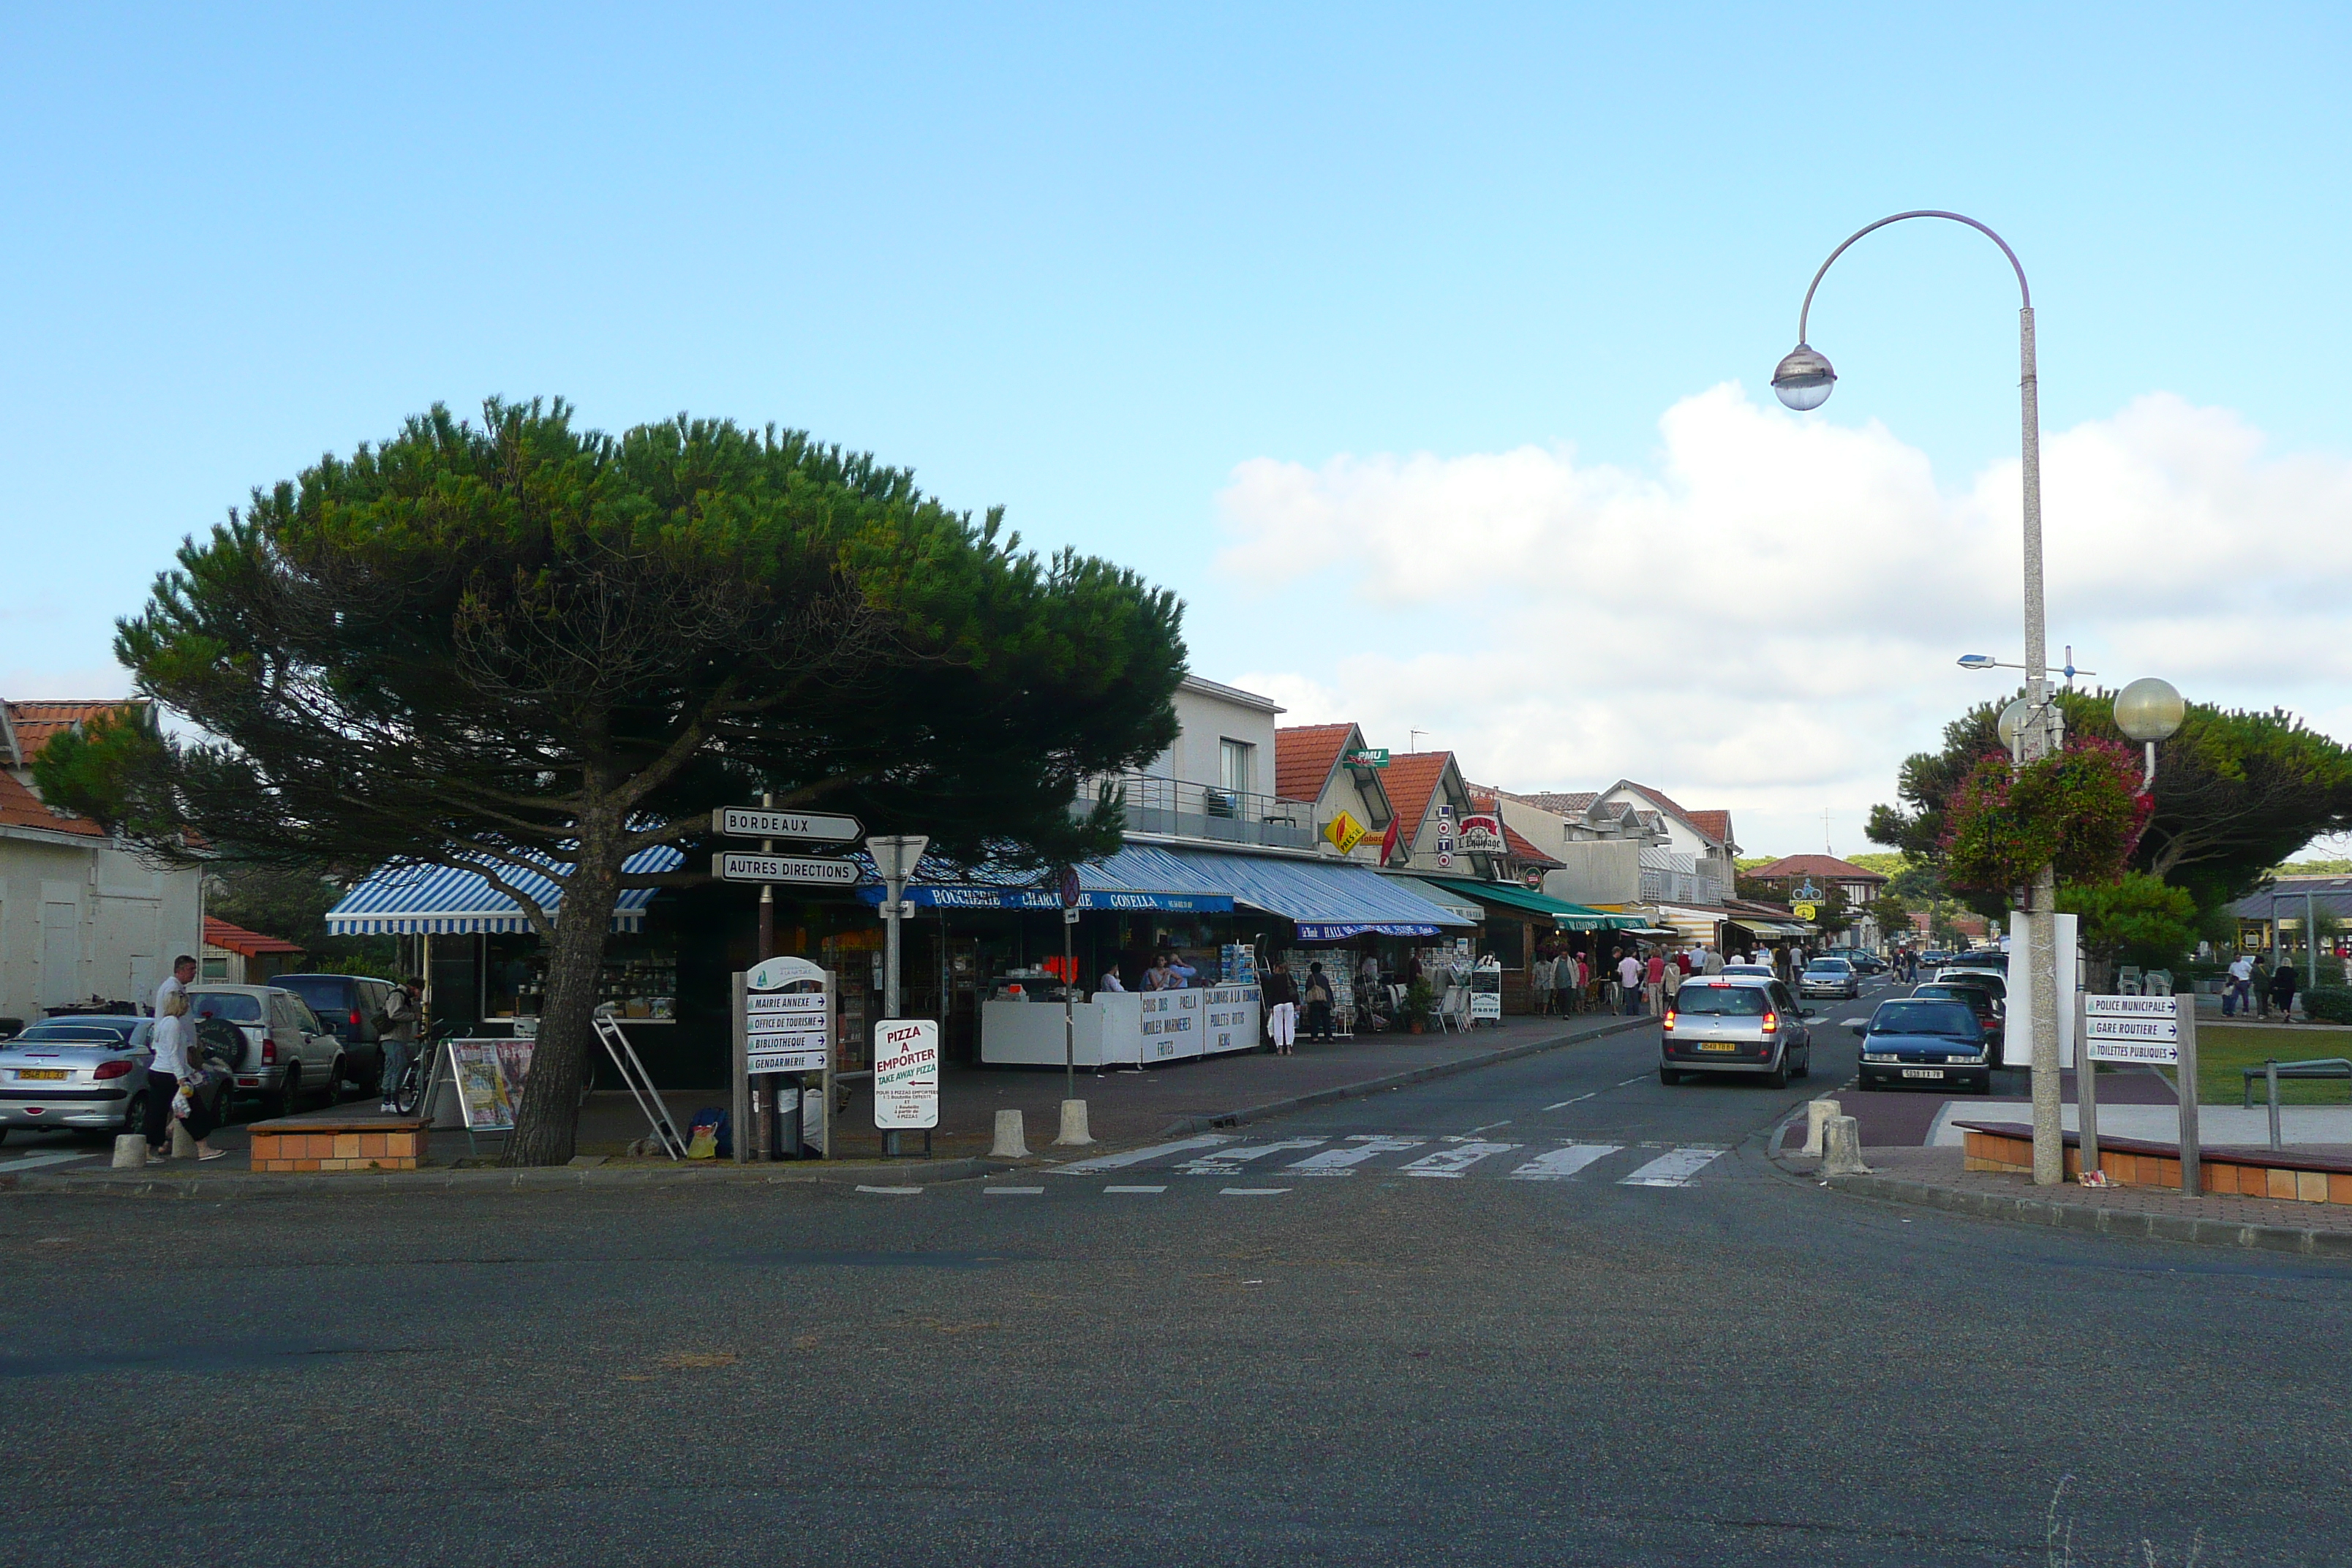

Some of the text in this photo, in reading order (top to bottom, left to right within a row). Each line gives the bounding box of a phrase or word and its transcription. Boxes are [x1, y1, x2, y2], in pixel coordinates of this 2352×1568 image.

[1358, 751, 1382, 760] PMU
[730, 815, 807, 832] BORDEAUX
[1466, 816, 1495, 829] BAR
[730, 860, 849, 878] AUTRES DIRECTIONS
[755, 998, 810, 1009] MAIRIE ANNEXE
[1180, 995, 1196, 1009] PAELLA
[1205, 990, 1229, 1005] CALAMARS
[1230, 990, 1234, 1003] A
[1235, 990, 1240, 1003] LA
[2095, 1000, 2166, 1011] POLICE MUNICIPALE
[755, 1017, 816, 1028] OFFICE DE TOURISME
[1210, 1013, 1229, 1027] POULETS
[1143, 1019, 1161, 1036] MOULES
[2096, 1022, 2157, 1035] GARE ROUTIERE
[887, 1026, 921, 1044] PIZZA
[1218, 1033, 1230, 1047] NEMS
[755, 1037, 805, 1049] BIBLIOTHEQUE
[901, 1042, 909, 1053] A
[1158, 1041, 1173, 1056] FRITES
[2097, 1045, 2167, 1058] TOILETTES PUBLIQUES
[755, 1057, 805, 1068] GENDARMERIE
[877, 1049, 935, 1073] EMPORTER
[878, 1063, 936, 1085] TAKE AWAY PIZZA
